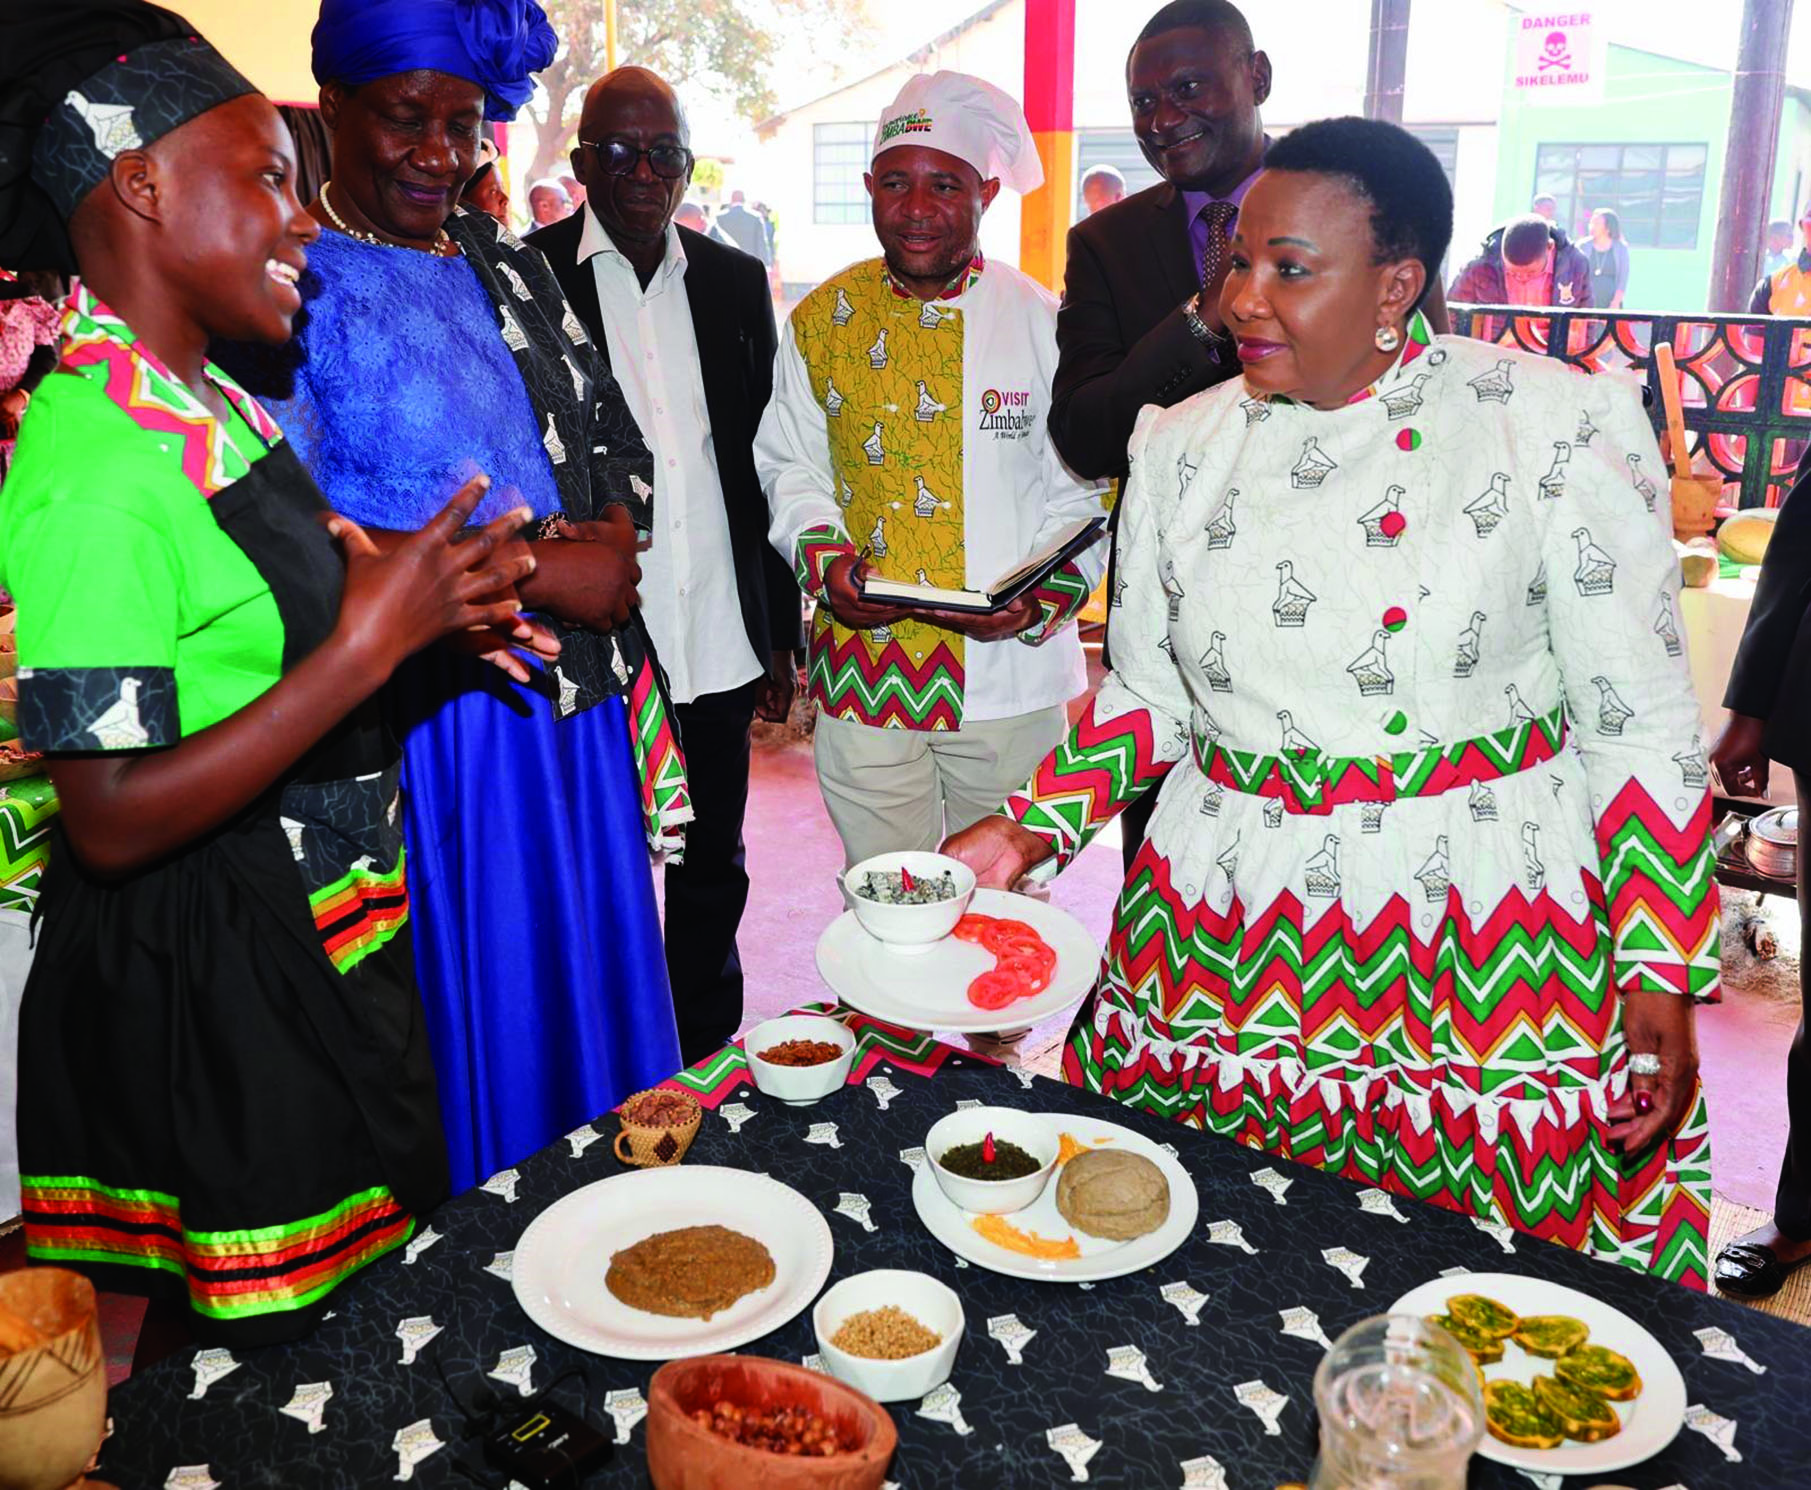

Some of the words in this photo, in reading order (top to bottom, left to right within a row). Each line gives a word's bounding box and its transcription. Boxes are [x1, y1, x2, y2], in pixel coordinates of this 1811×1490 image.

[1522, 13, 1591, 30] DANGER
[1515, 73, 1589, 87] SIKELEMU
[1001, 391, 1029, 406] VISIT
